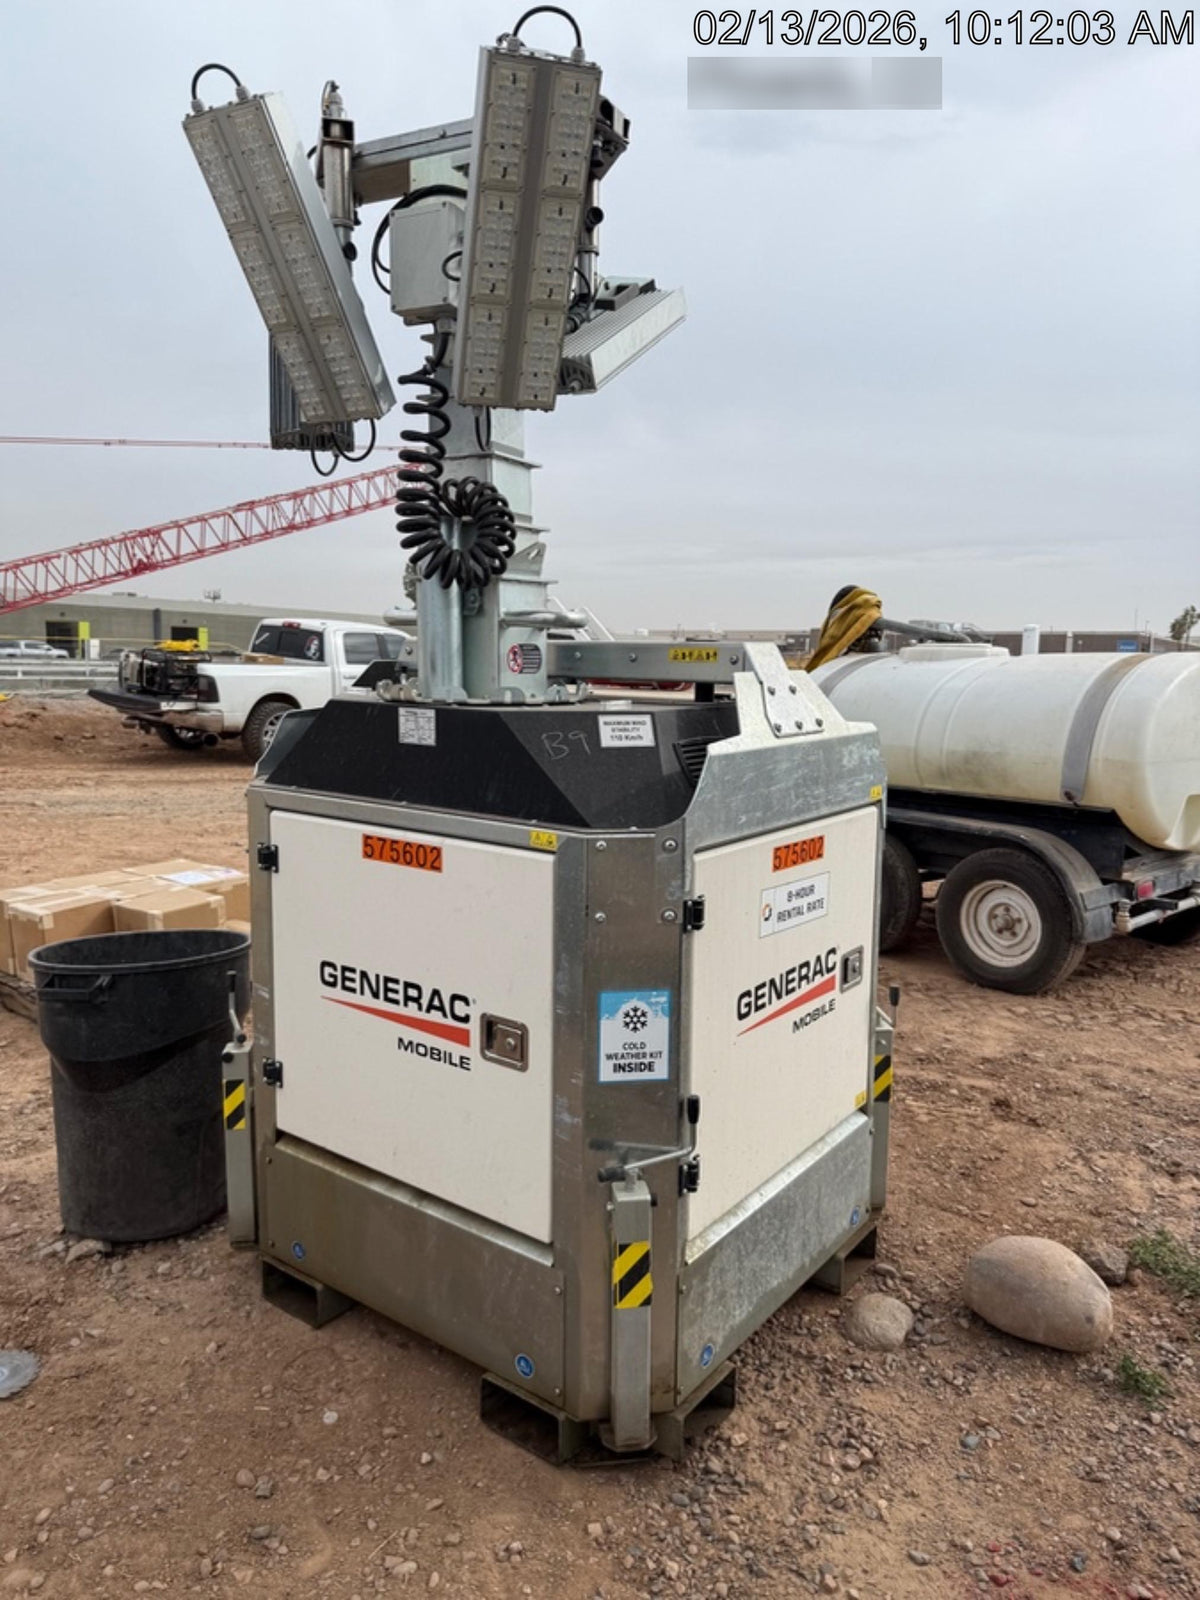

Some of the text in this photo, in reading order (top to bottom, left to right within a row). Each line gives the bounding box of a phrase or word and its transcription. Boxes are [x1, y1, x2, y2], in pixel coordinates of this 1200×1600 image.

[363, 835, 442, 871] 575602
[774, 836, 824, 870] 575602
[777, 897, 825, 923] RENTAL RATE
[787, 884, 815, 902] 8-HOUR
[320, 960, 471, 1024] GENERAC
[737, 946, 838, 1021] GENERAC
[792, 998, 836, 1034] MOBILE
[397, 1036, 472, 1071] MOBILE
[605, 1050, 663, 1061] WEATHER KIT
[622, 1041, 647, 1051] COLD
[612, 1061, 655, 1074] INSIDE
